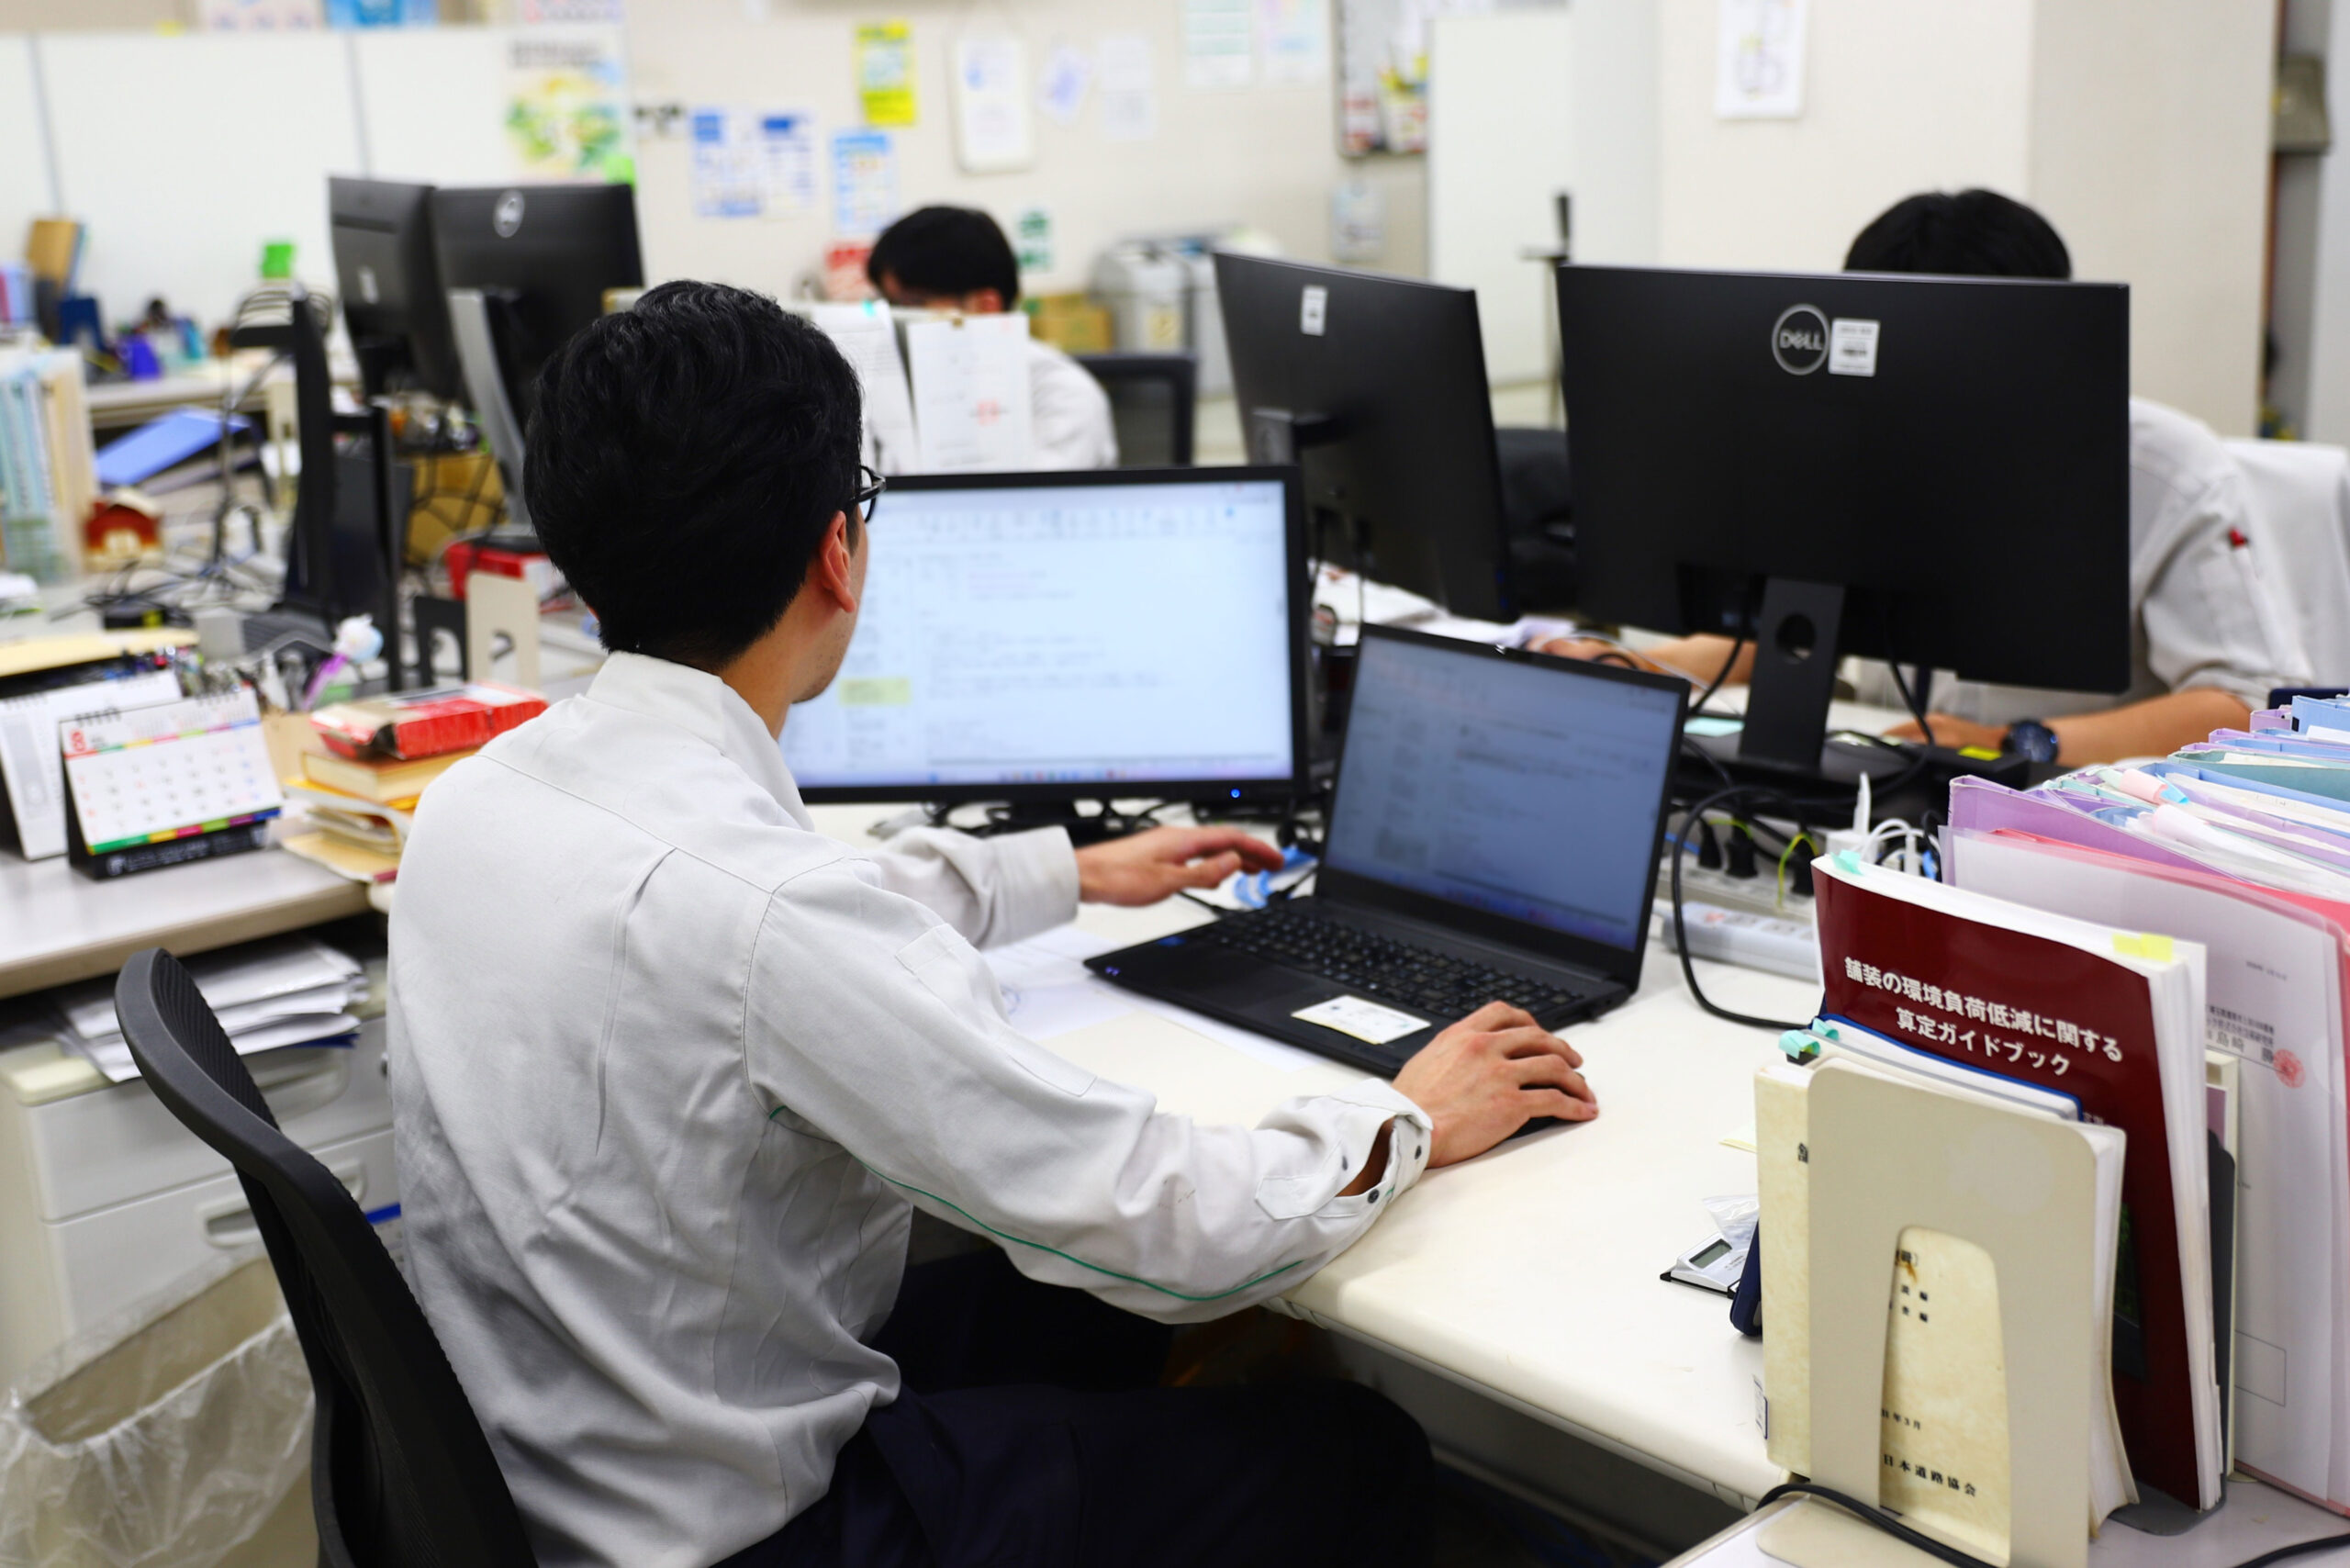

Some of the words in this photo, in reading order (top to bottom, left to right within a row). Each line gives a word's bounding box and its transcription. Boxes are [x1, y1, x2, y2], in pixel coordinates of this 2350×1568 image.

[1779, 330, 1822, 351] DELL
[1844, 957, 2123, 1062] 舗装の環境負荷低減に関する
[1896, 1006, 2070, 1077] 算定ガイドブック
[1884, 1453, 1975, 1497] 日本道路協会
